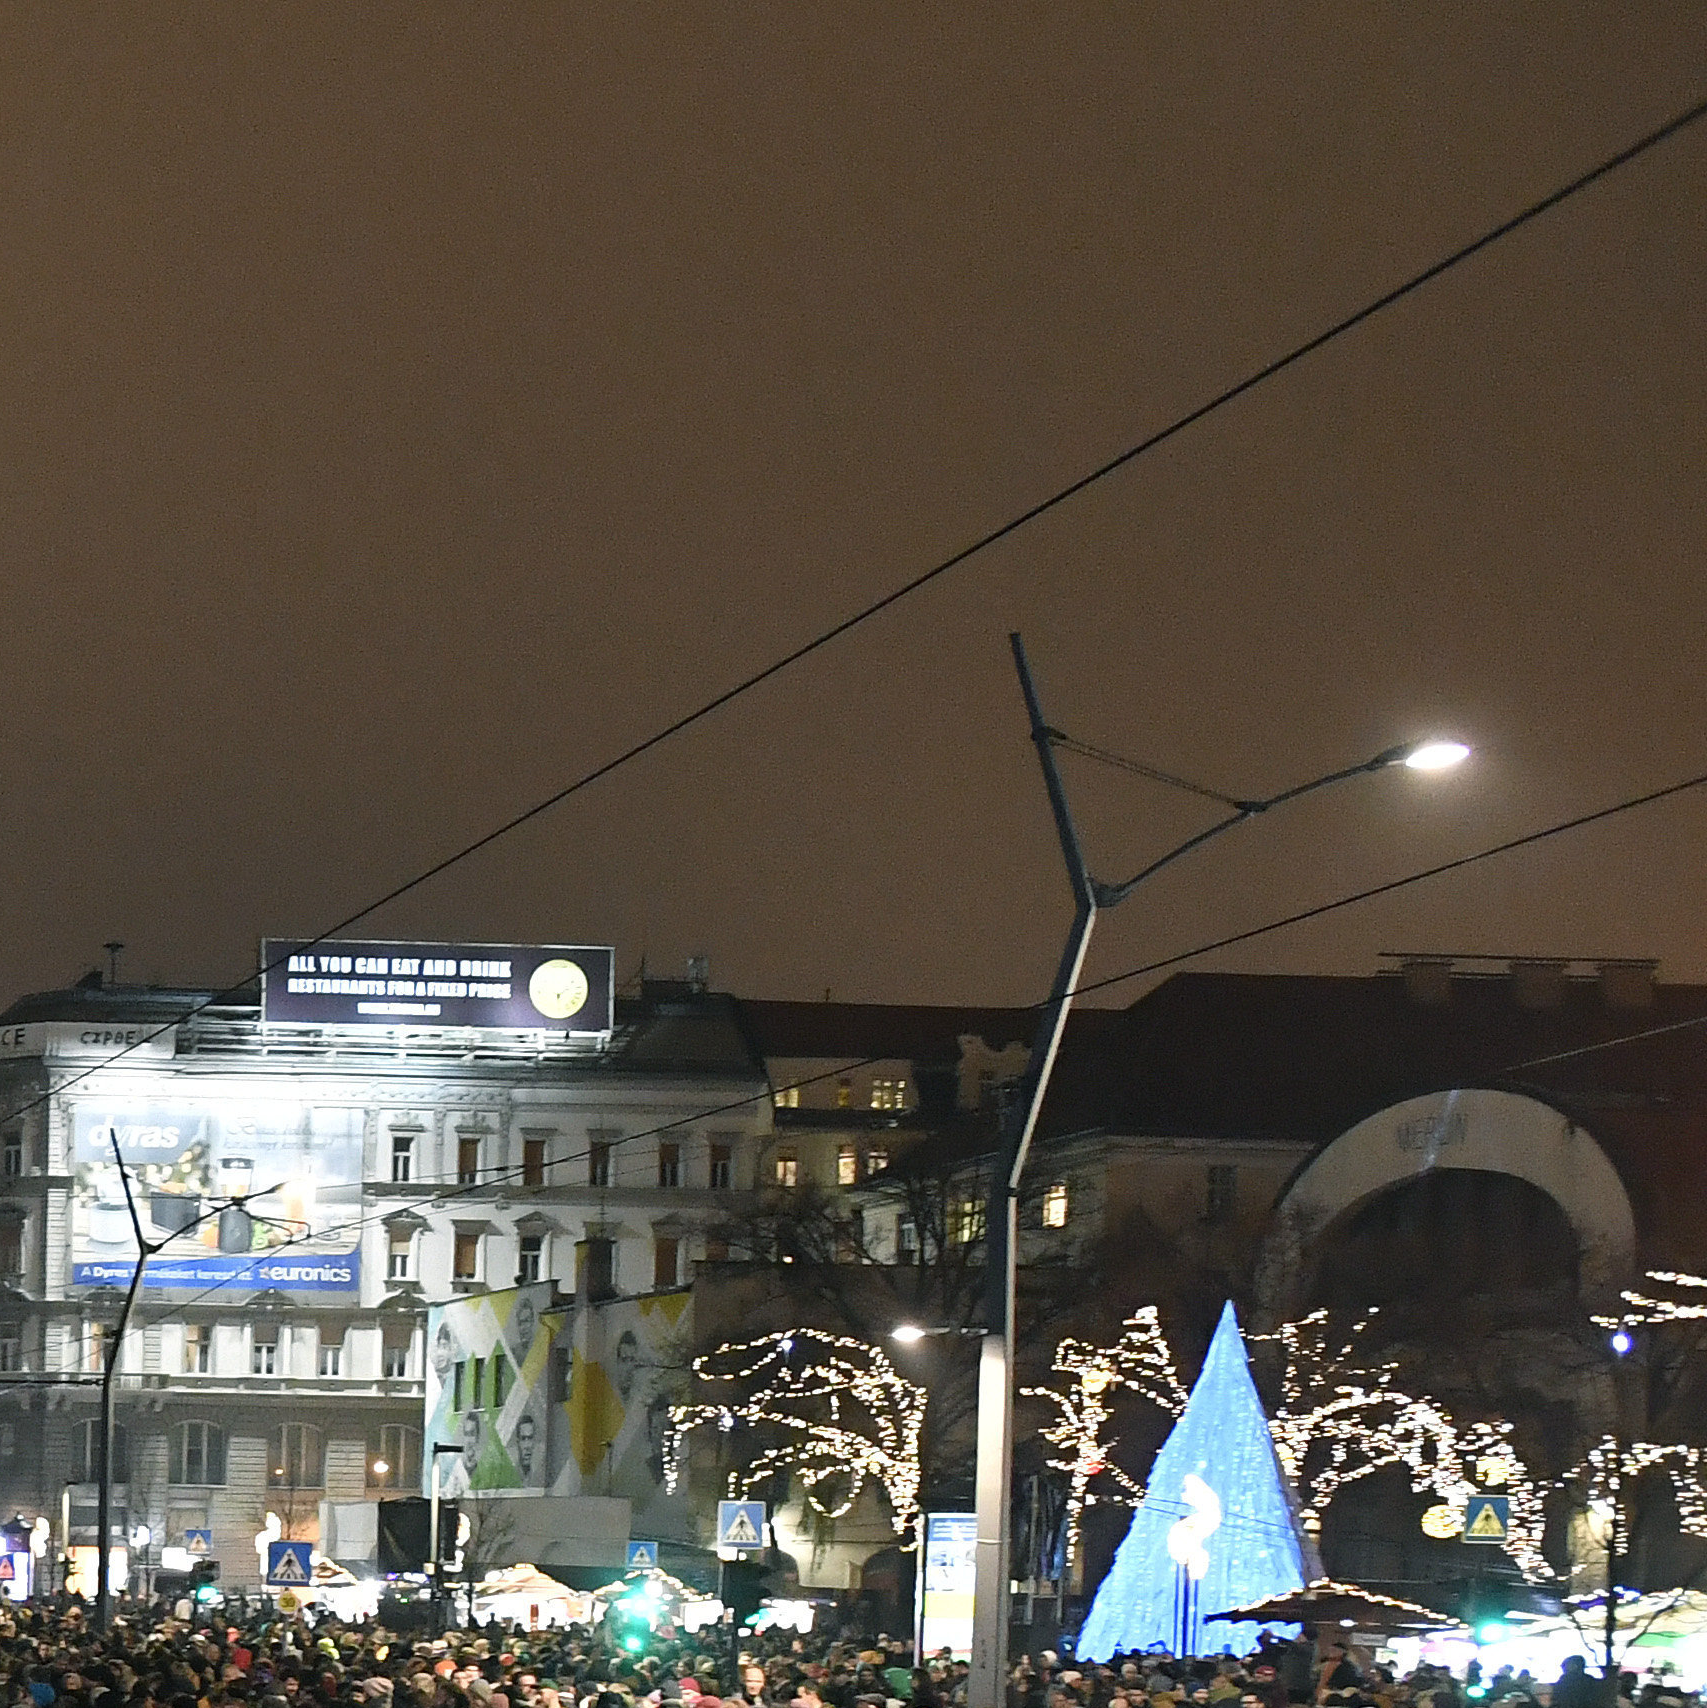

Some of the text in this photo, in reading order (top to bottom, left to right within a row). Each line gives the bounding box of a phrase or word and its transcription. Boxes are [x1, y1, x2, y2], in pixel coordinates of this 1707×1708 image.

[288, 955, 511, 977] ALL YOU CAN EAT AND DRINK
[288, 978, 511, 998] RESTAURANTS FOR A FIXED PRICE
[88, 1116, 180, 1156] dyras
[271, 1264, 351, 1282] euronics
